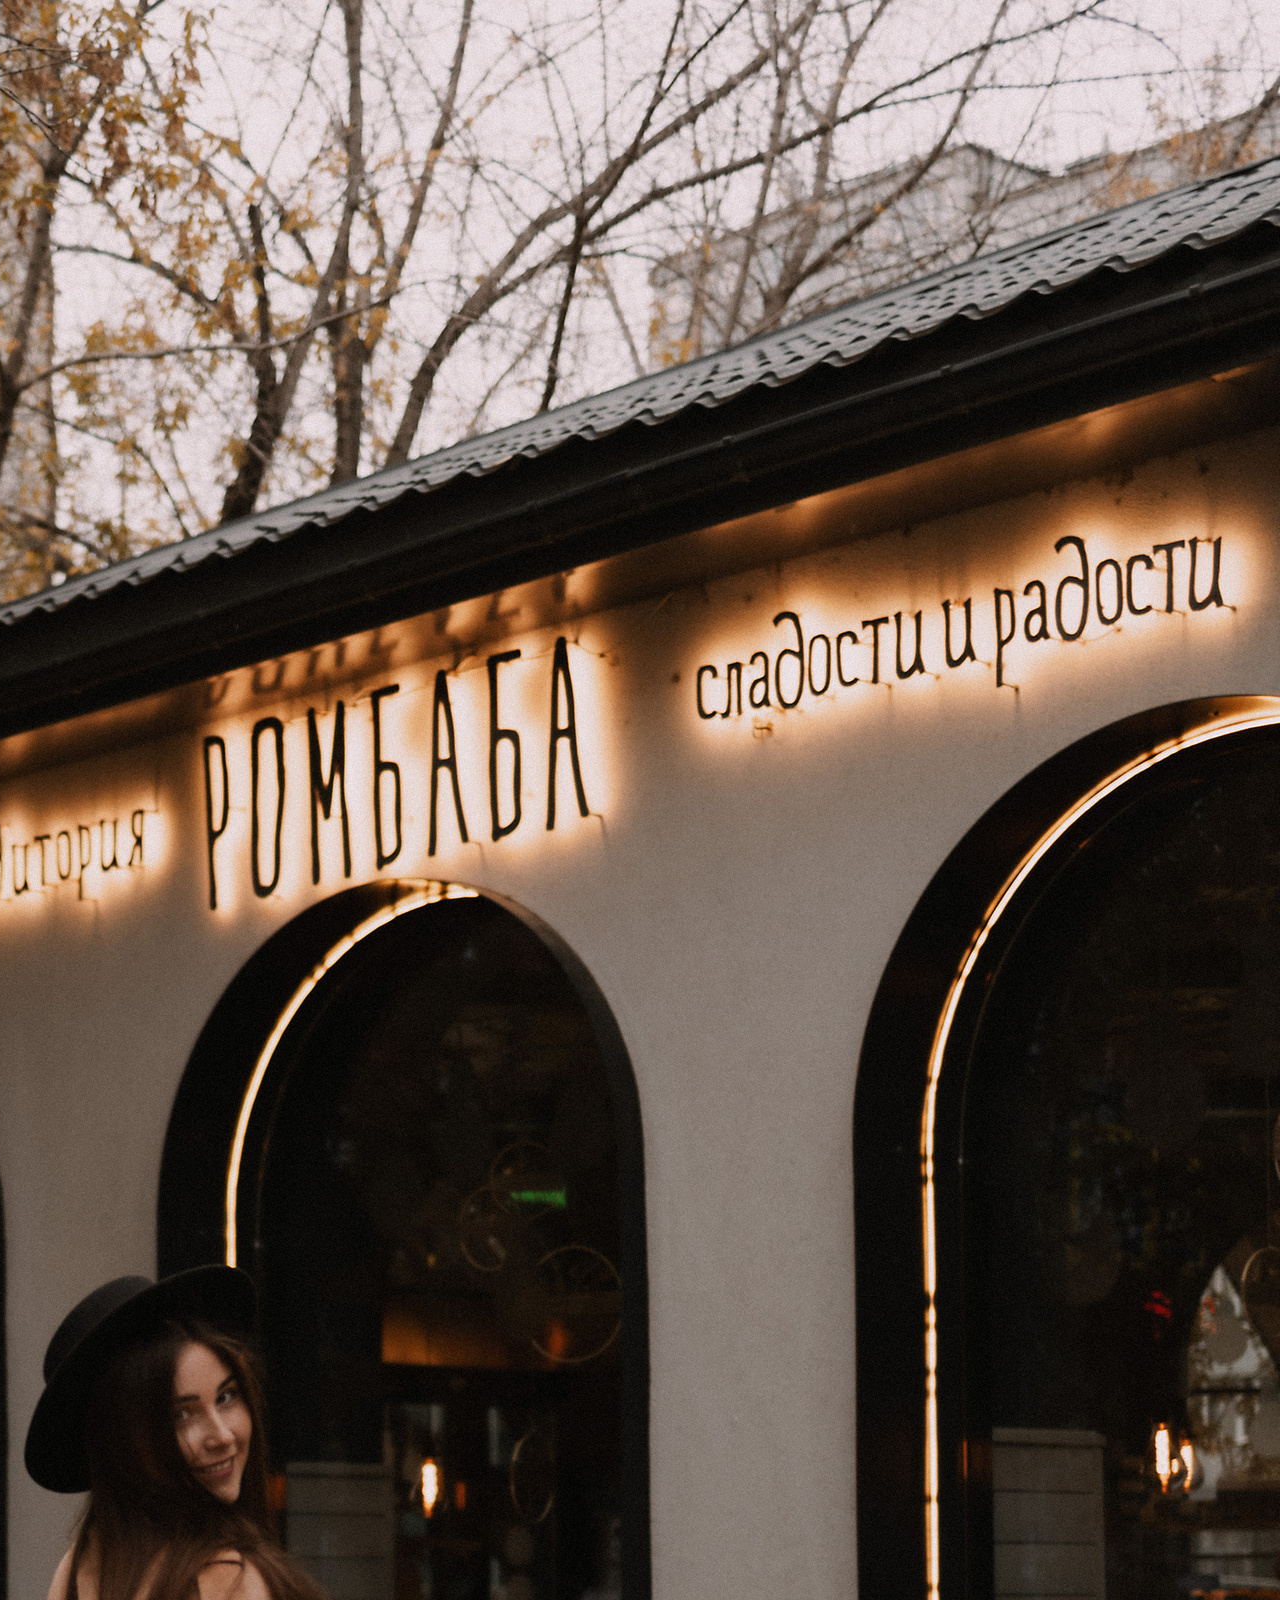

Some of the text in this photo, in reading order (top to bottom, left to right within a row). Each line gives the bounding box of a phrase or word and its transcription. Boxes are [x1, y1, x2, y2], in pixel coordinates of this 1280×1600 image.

[695, 535, 1224, 720] сладости и радости
[203, 636, 590, 910] РОМБАБА
